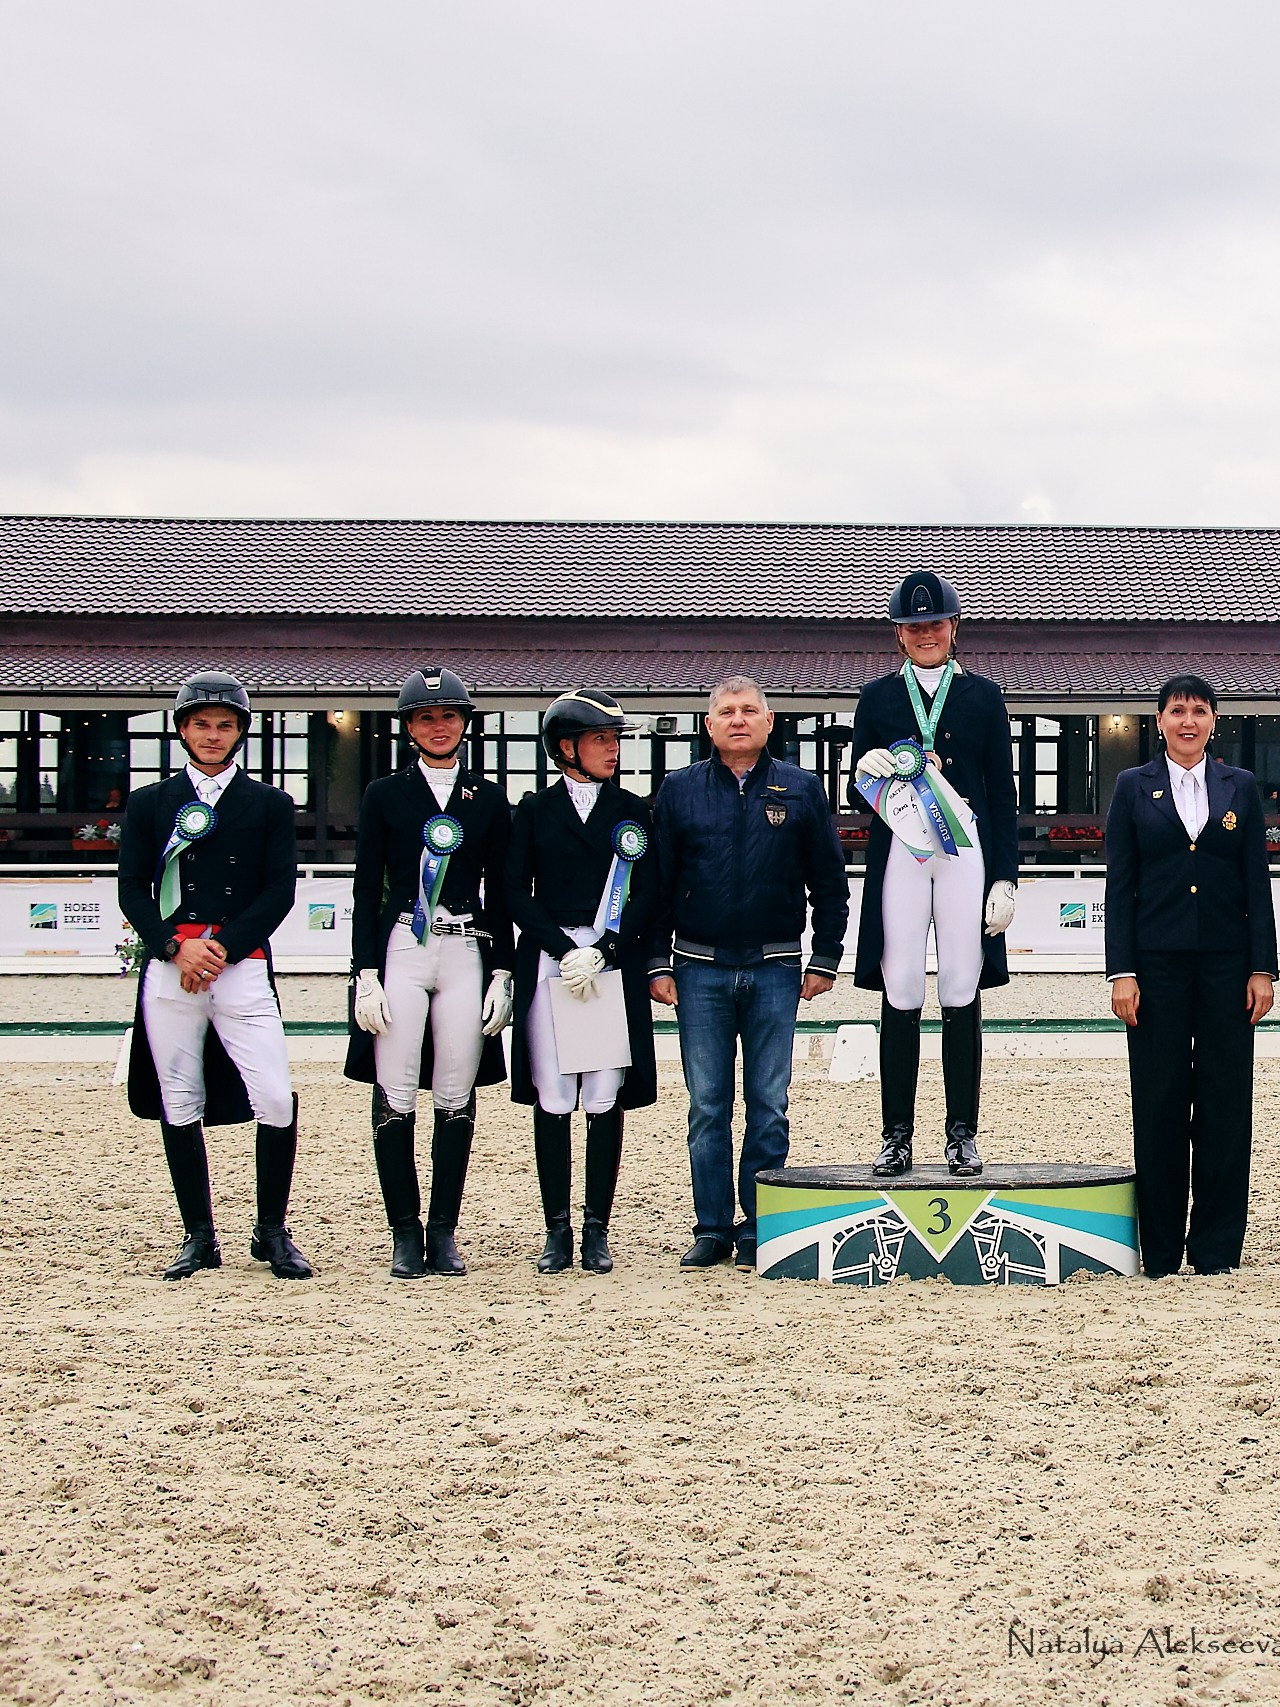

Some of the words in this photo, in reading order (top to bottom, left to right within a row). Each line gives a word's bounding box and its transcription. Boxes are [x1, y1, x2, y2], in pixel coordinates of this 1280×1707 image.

[861, 775, 879, 791] DIPL
[928, 801, 951, 842] EURASIA
[63, 903, 100, 912] HORSE
[609, 886, 622, 921] EURASIA
[63, 915, 100, 923] EXPERT
[926, 1197, 952, 1235] 3
